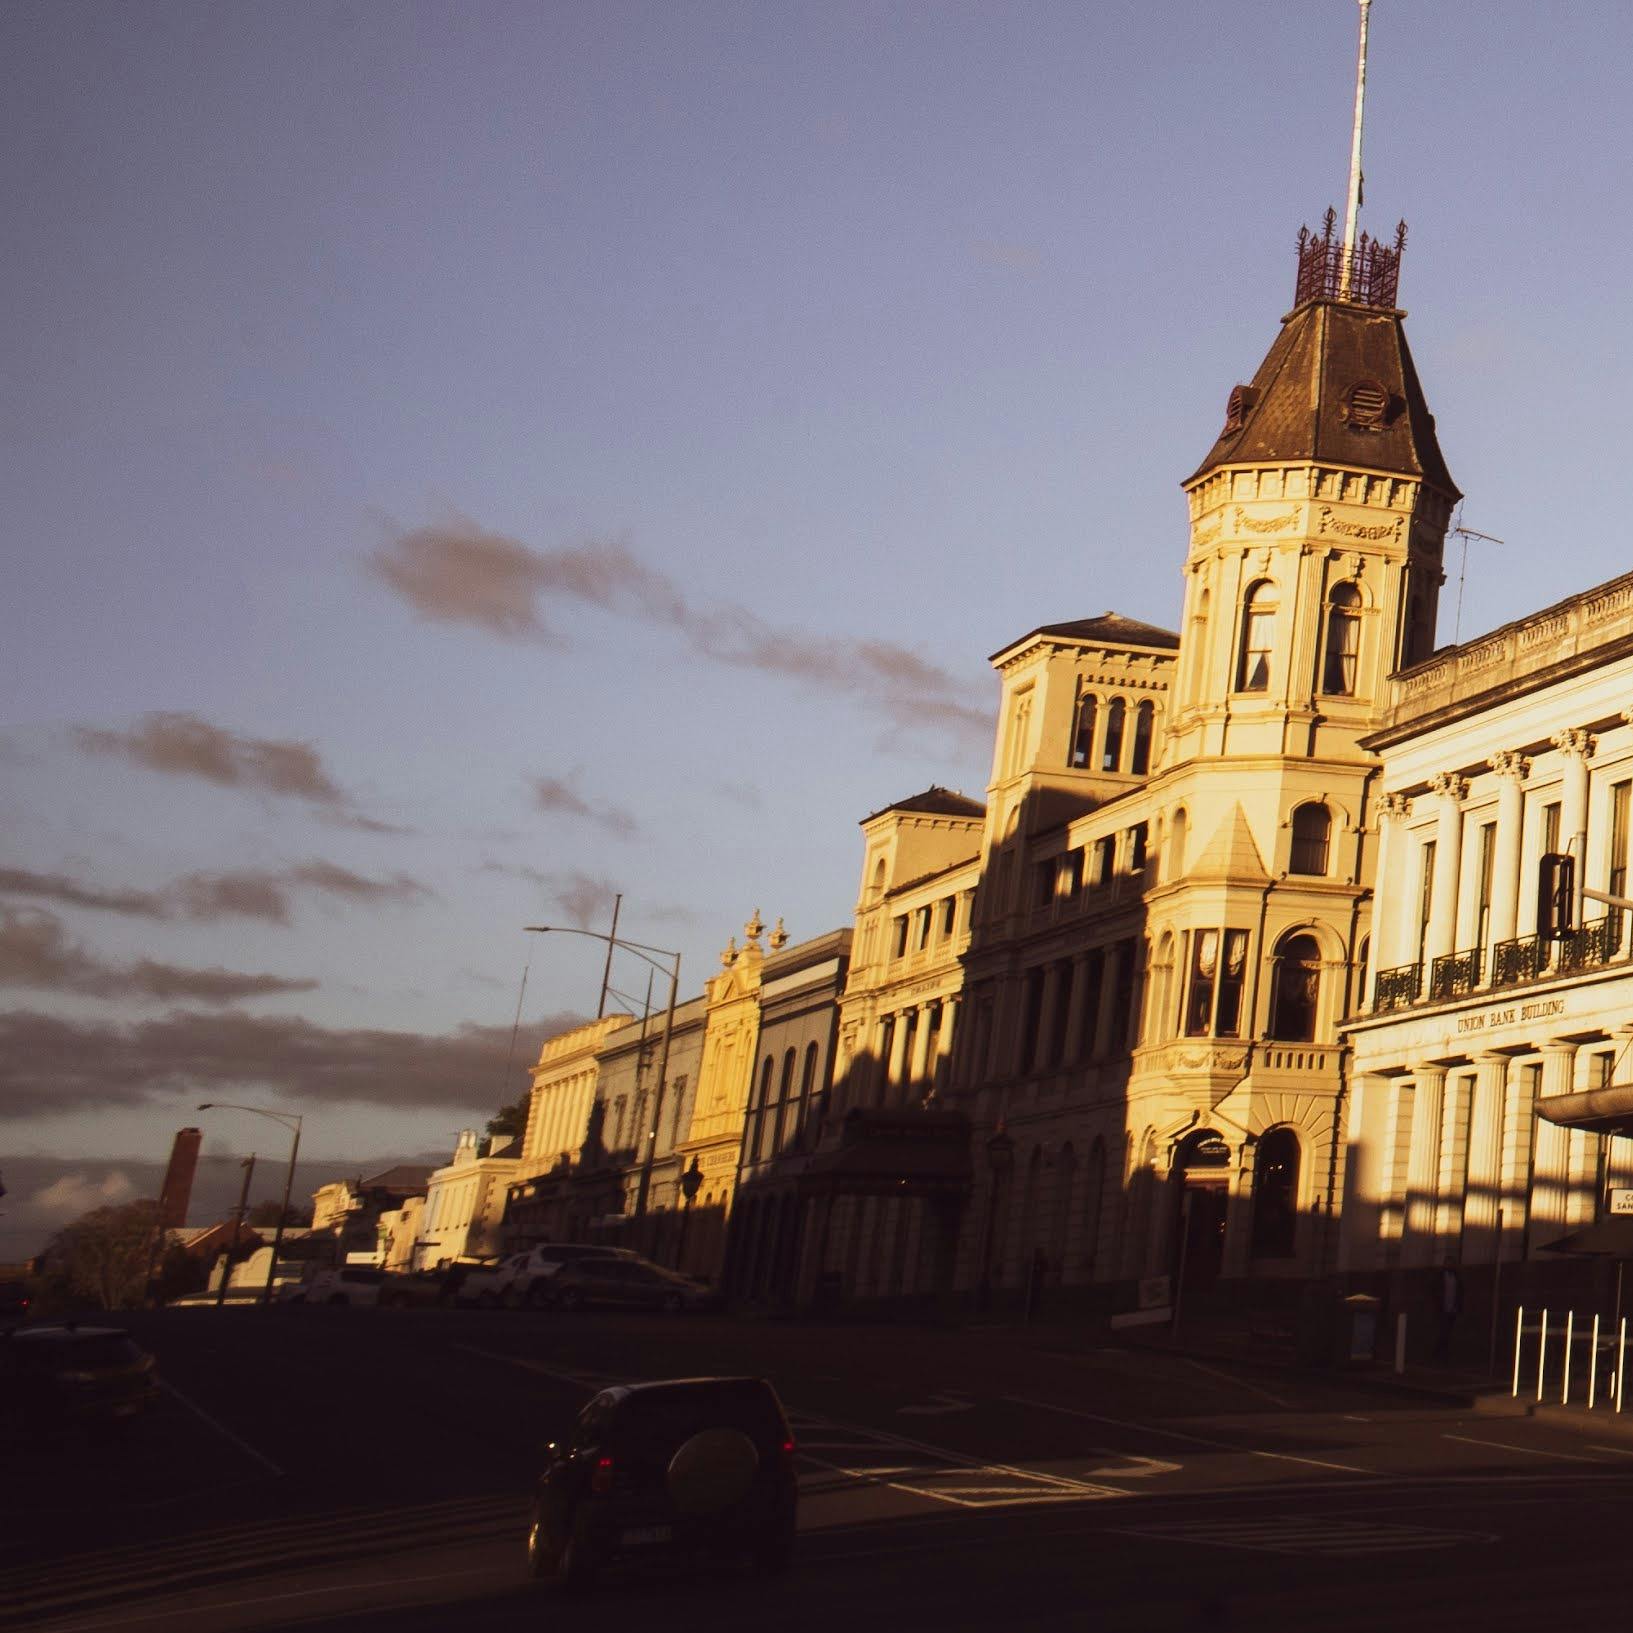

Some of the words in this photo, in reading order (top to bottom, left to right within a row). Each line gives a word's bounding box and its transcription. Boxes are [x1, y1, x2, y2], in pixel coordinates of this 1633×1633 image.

[1457, 1014, 1486, 1033] UNION
[1490, 1009, 1515, 1027] BANK
[1520, 1000, 1564, 1021] BUILDING
